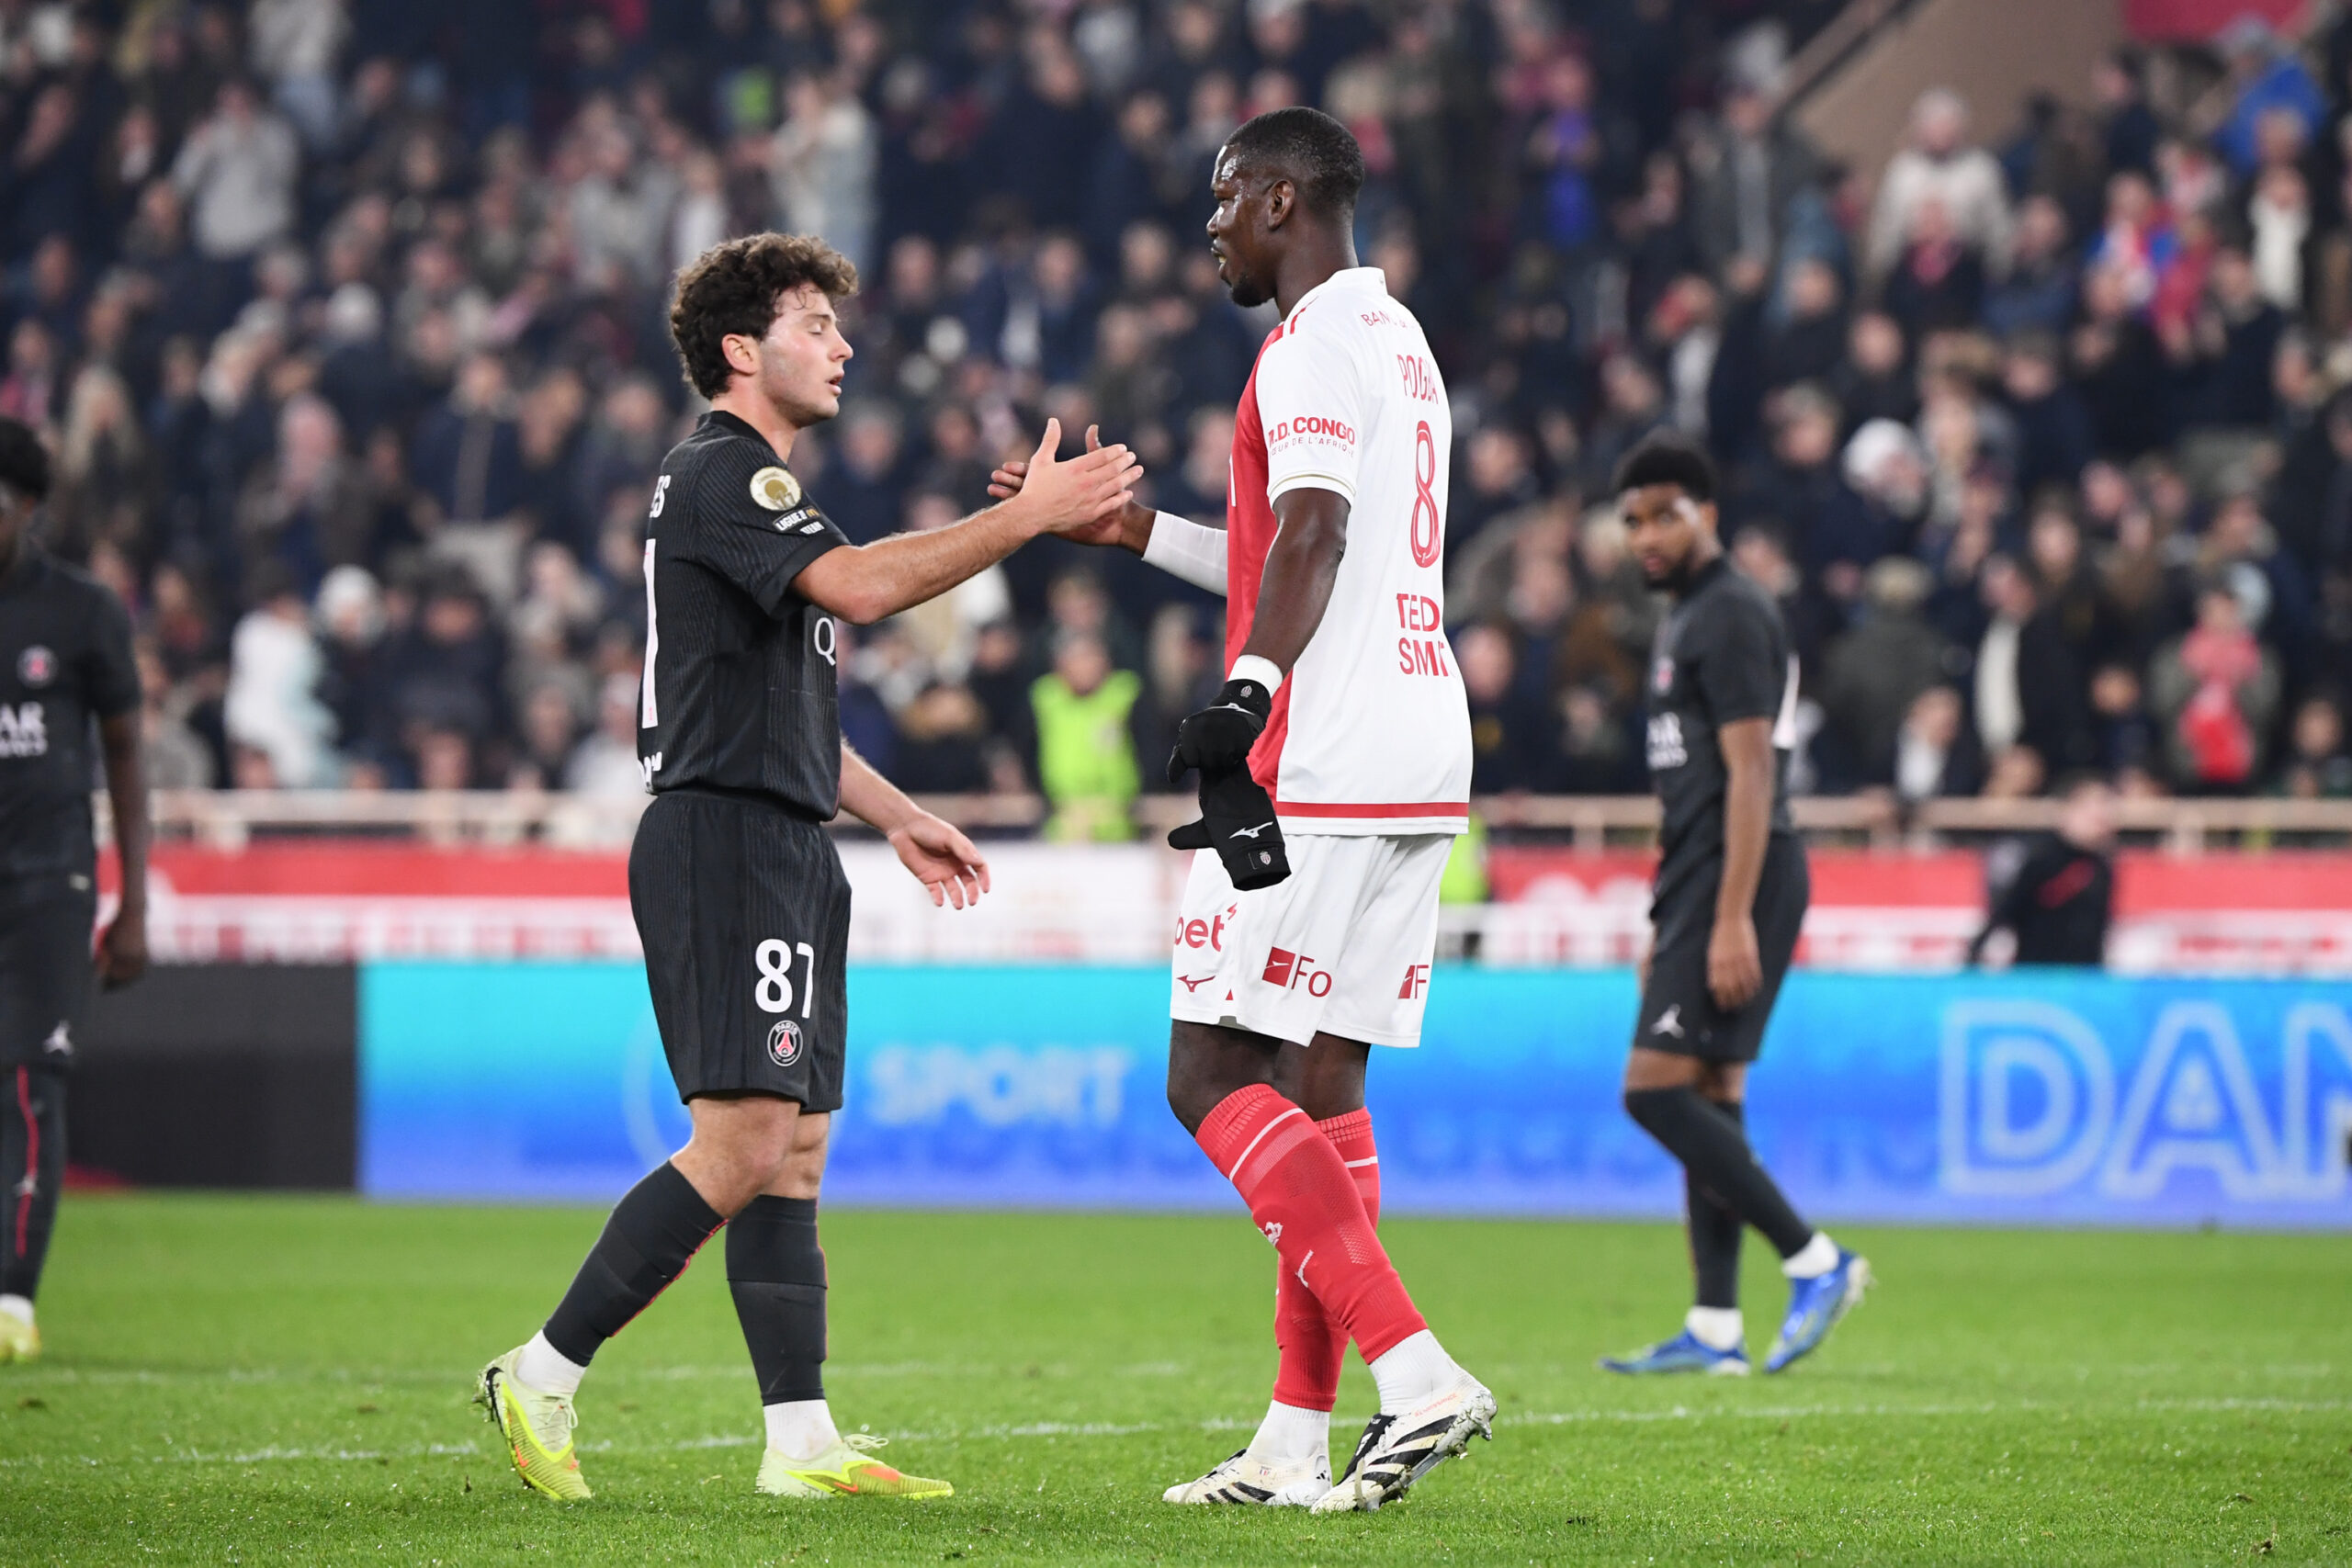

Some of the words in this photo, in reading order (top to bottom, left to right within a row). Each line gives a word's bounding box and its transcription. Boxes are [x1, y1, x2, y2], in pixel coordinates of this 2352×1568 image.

[1293, 416, 1355, 446] CONGO
[1410, 420, 1442, 568] 8
[1396, 592, 1441, 632] TED
[754, 938, 815, 1019] 87
[867, 1043, 1130, 1126] SPORT
